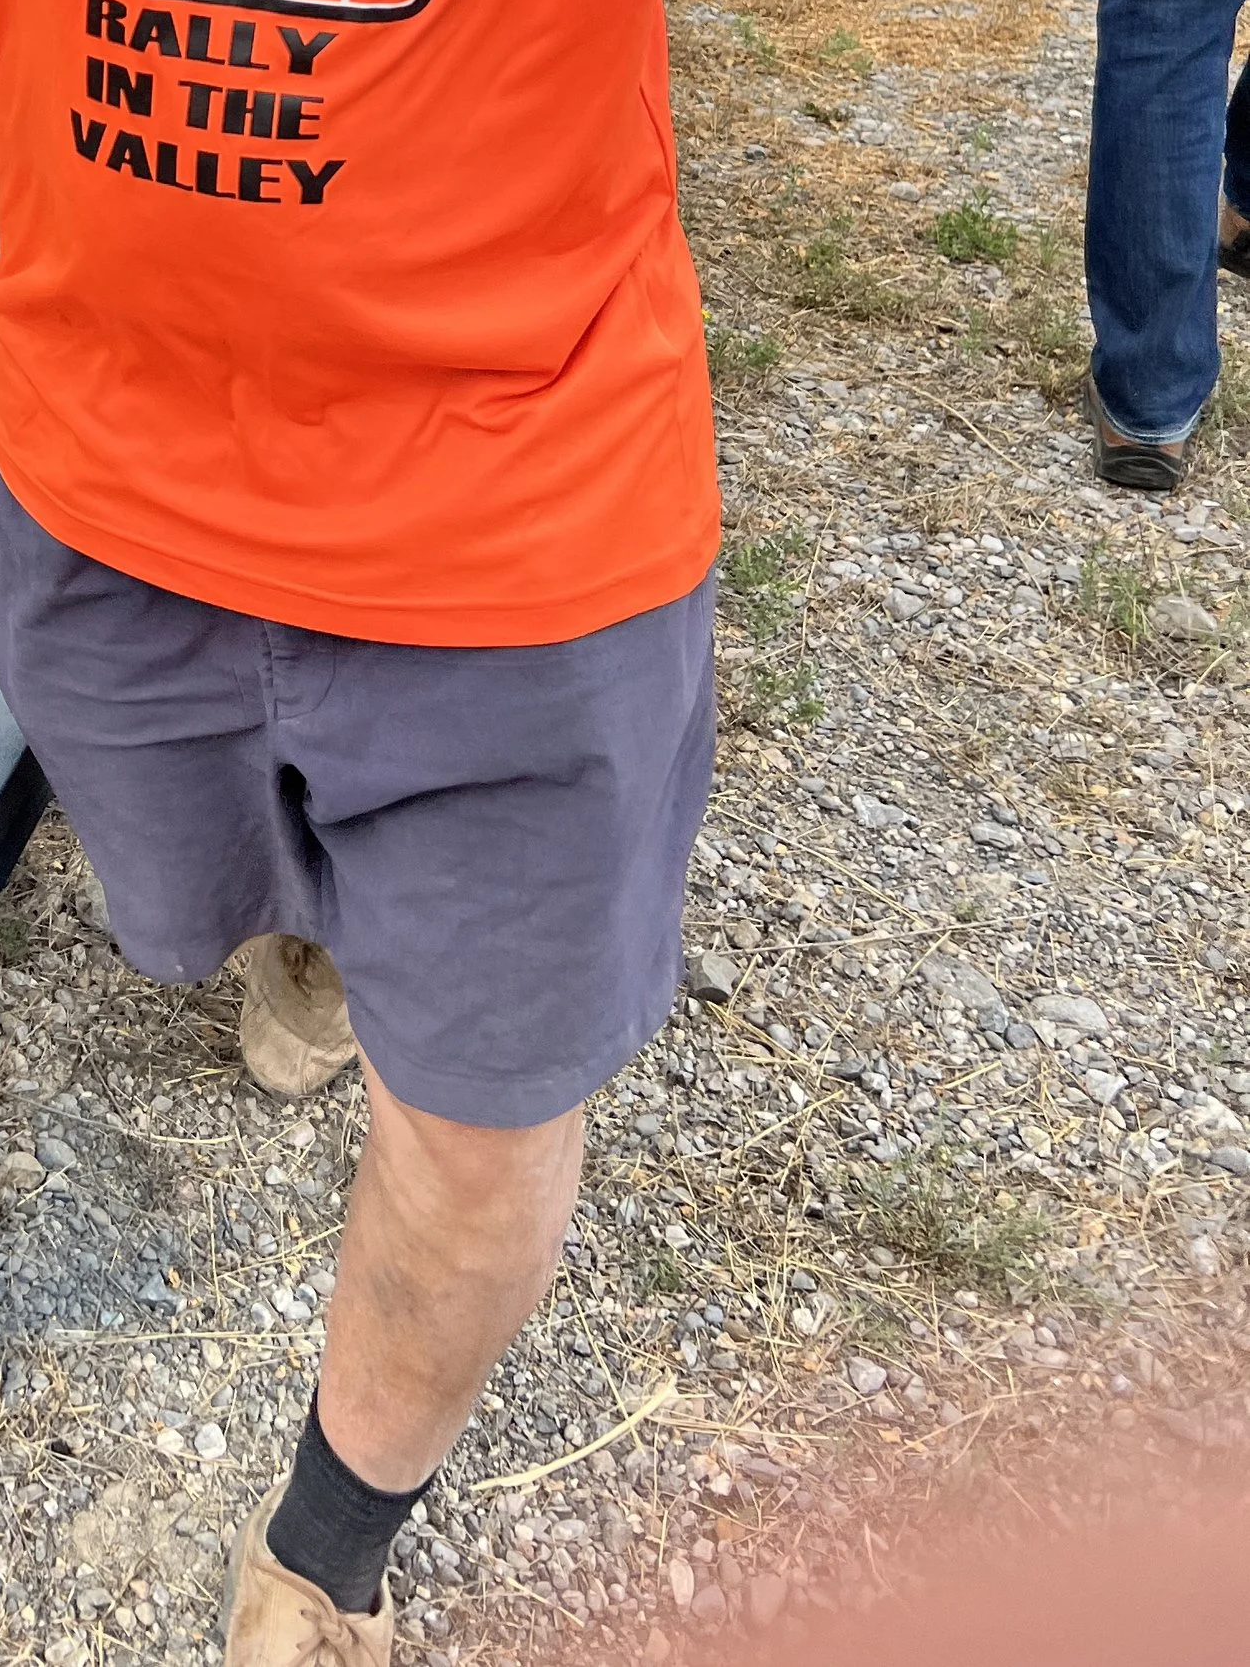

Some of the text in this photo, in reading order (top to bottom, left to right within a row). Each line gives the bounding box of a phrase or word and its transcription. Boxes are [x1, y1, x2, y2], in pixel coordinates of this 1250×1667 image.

[86, 56, 325, 140] IN THE
[70, 108, 347, 205] VALLEY
